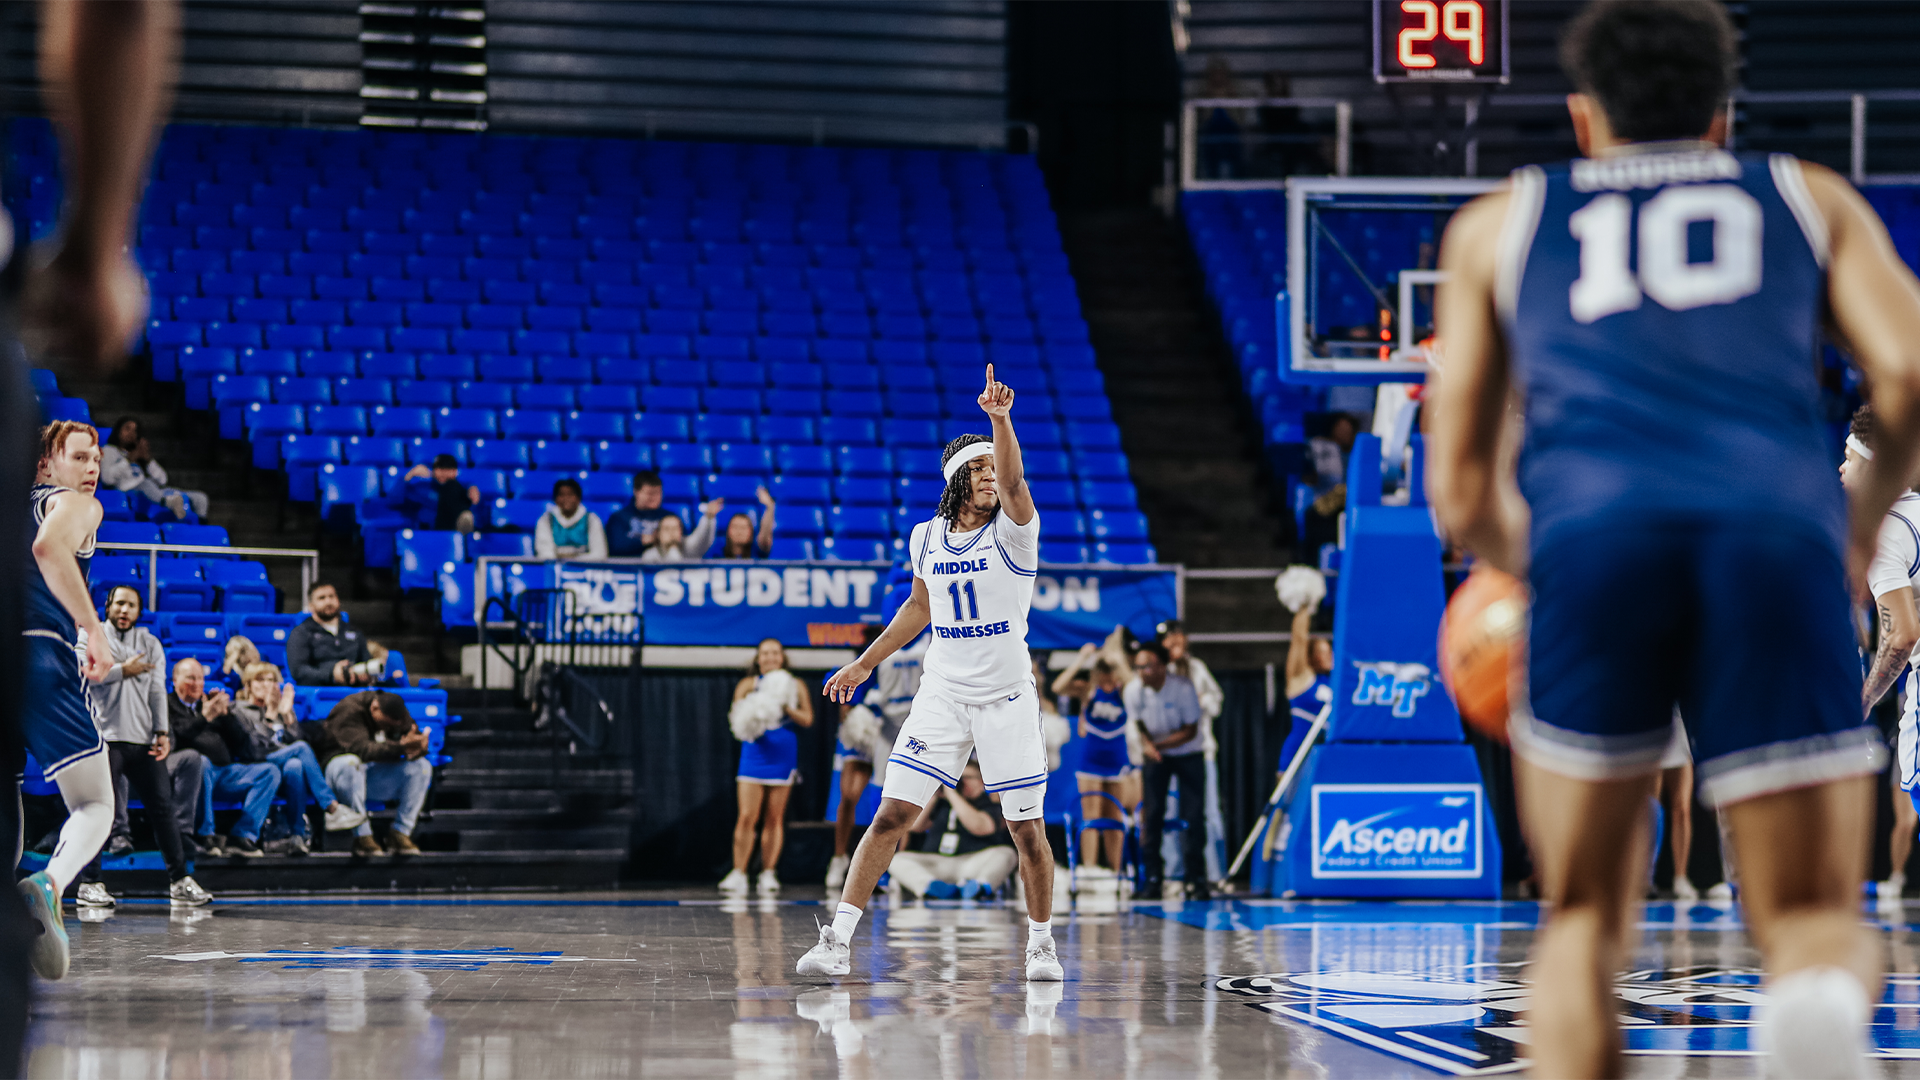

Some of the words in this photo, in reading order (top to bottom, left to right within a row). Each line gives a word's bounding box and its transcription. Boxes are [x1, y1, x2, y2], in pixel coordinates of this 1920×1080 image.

[1398, 0, 1484, 68] 29
[1569, 184, 1764, 324] 10
[932, 558, 989, 575] MIDDLE
[653, 568, 878, 607] STUDENT
[1031, 576, 1100, 613] ON
[947, 578, 980, 622] 11
[935, 620, 1010, 639] TENNESSEE
[1352, 663, 1430, 718] MT
[905, 736, 929, 756] MT
[1321, 819, 1469, 854] Ascend
